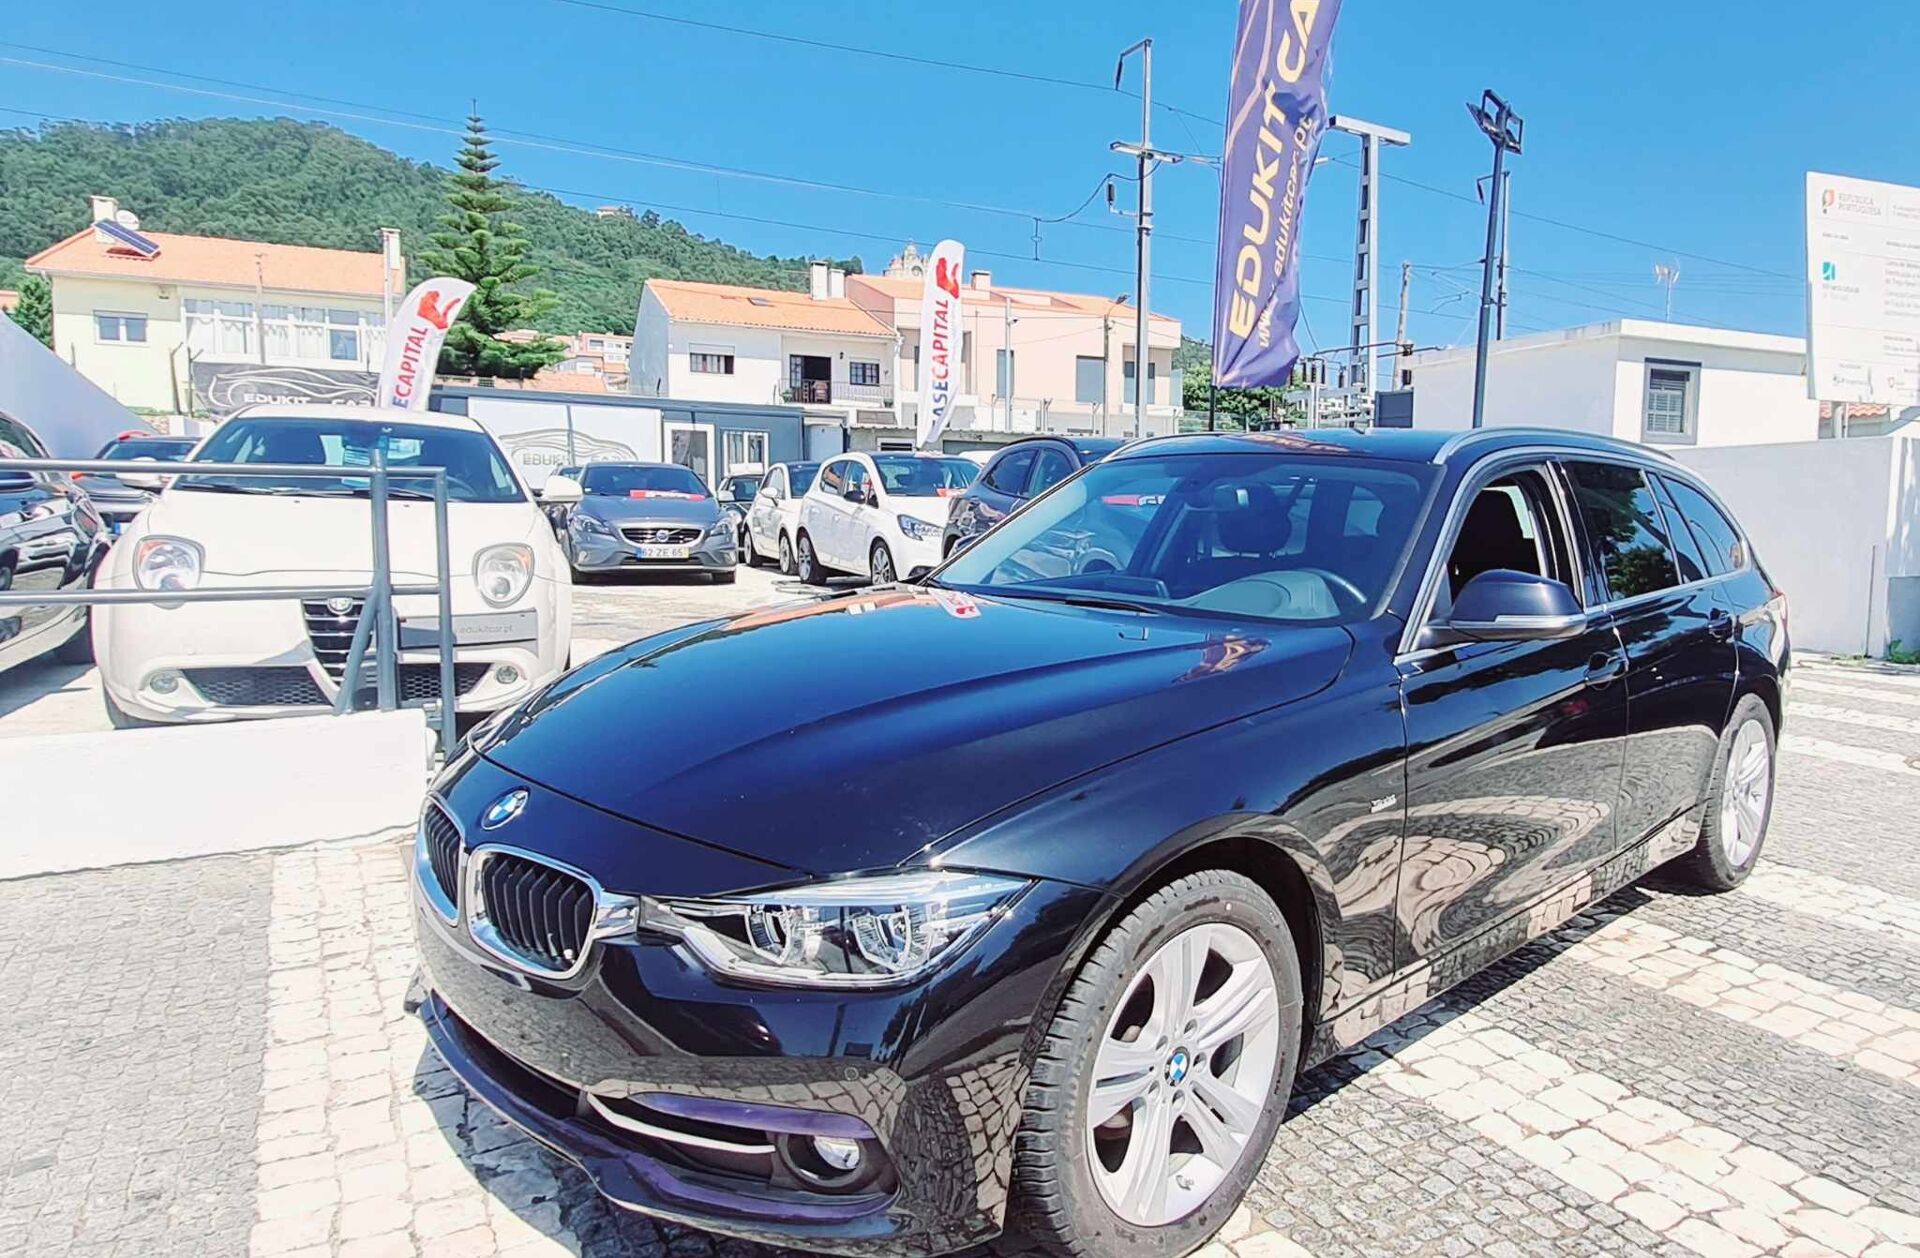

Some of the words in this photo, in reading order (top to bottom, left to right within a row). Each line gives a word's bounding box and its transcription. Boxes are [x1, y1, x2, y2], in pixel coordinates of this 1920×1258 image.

[1229, 79, 1286, 340] EDUKIT
[243, 392, 312, 405] EDUKIT
[931, 299, 949, 429] ASECAPITAL
